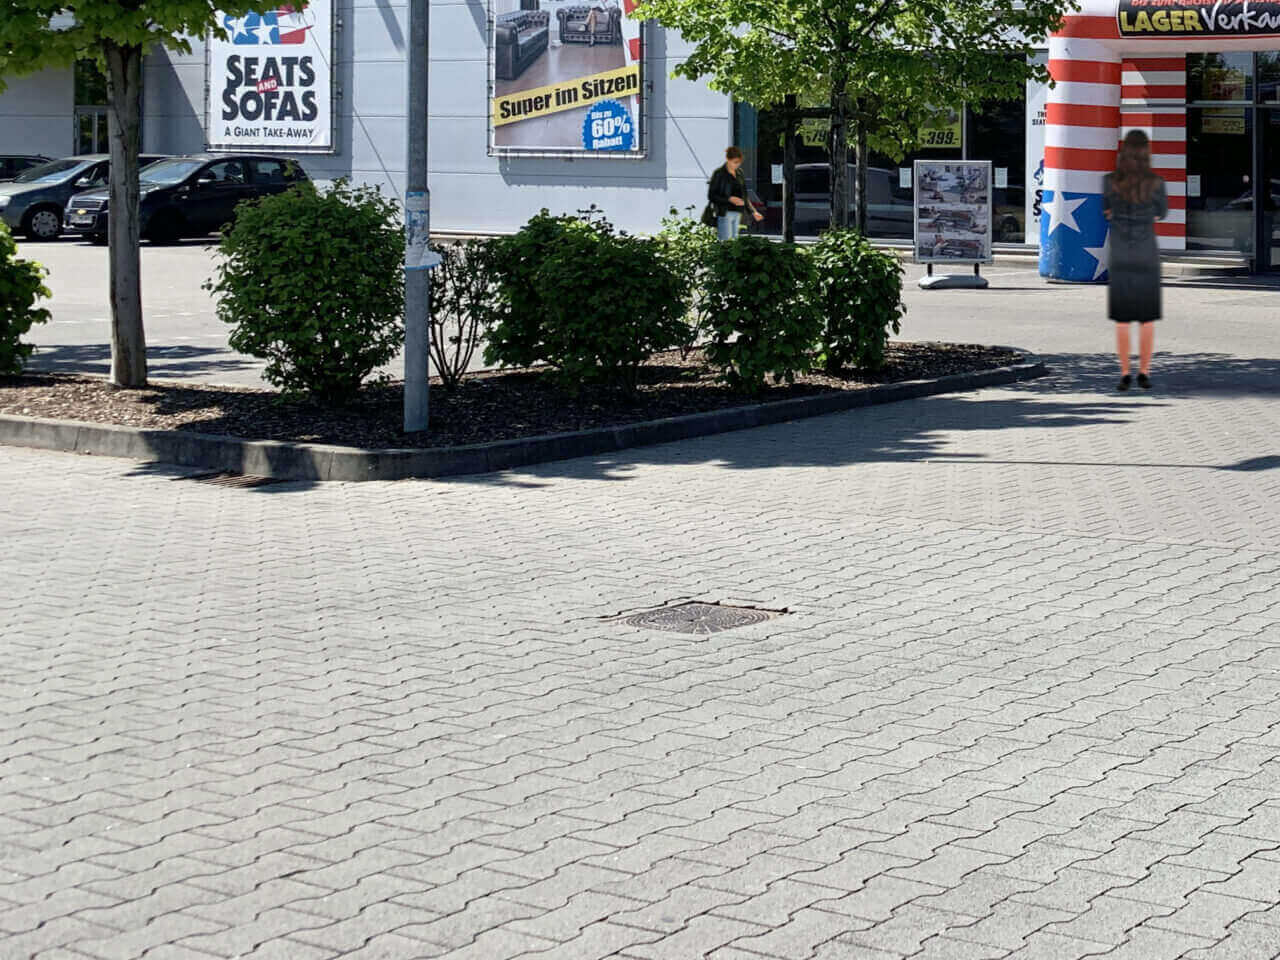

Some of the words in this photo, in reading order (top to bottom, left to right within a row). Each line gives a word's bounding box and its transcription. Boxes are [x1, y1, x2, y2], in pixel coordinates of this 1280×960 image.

[226, 54, 316, 89] SEATS
[257, 79, 278, 91] AND
[222, 87, 318, 122] SOFAS
[499, 92, 553, 119] Super
[555, 86, 578, 107] im
[581, 72, 638, 100] Sitzen
[224, 126, 232, 137] A
[233, 126, 261, 138] GIANT
[263, 127, 315, 139] TAKE-AWAY
[591, 114, 631, 138] 60%
